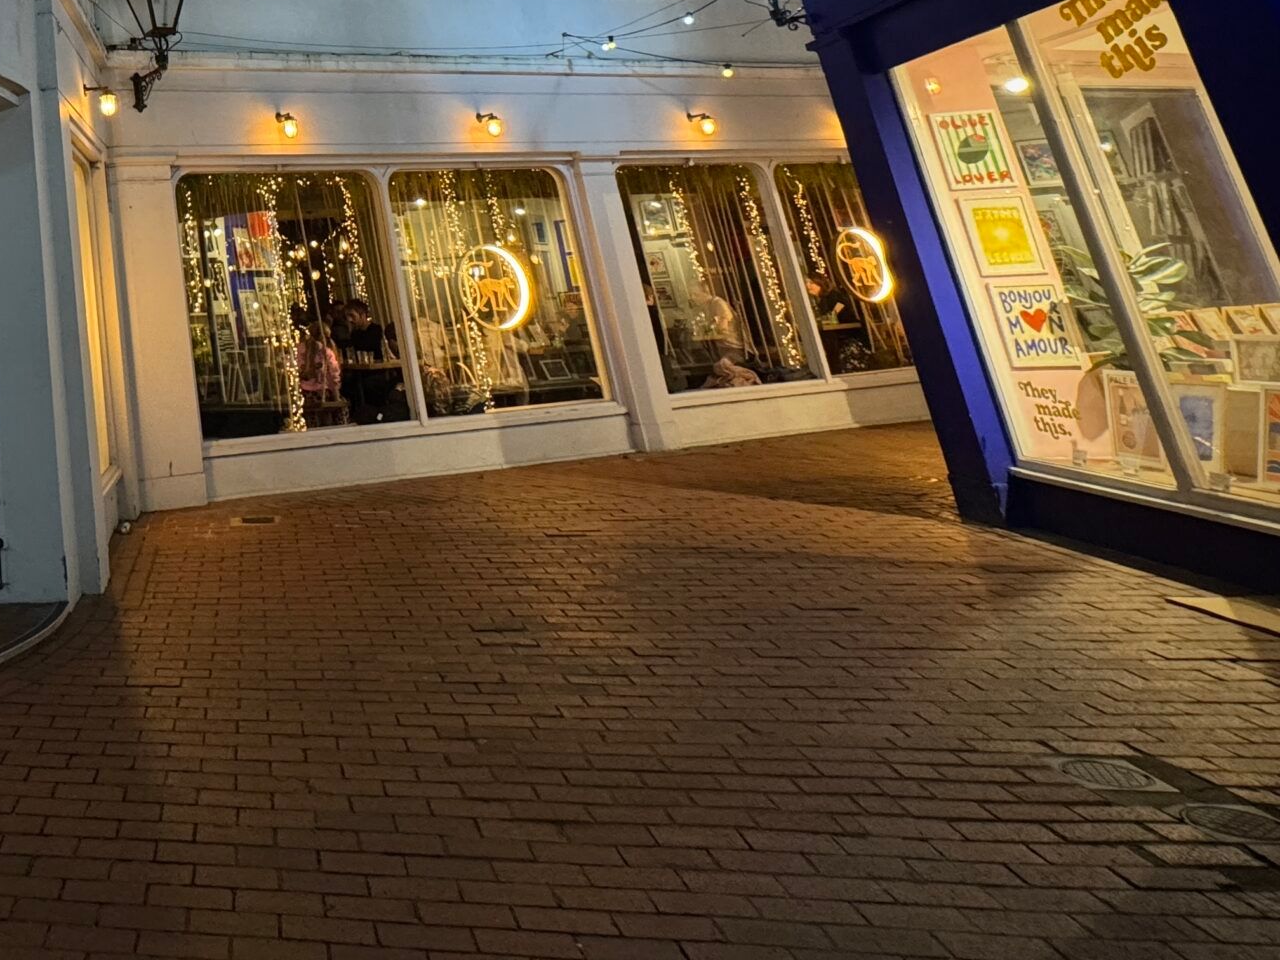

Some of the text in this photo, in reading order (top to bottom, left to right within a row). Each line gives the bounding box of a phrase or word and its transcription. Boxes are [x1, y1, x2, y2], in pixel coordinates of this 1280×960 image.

[938, 115, 989, 130] OLIVE
[954, 170, 1014, 185] LOVER
[1014, 336, 1072, 359] AMOUR
[1018, 381, 1057, 404] They
[1035, 400, 1081, 421] made
[1033, 415, 1073, 440] this.
